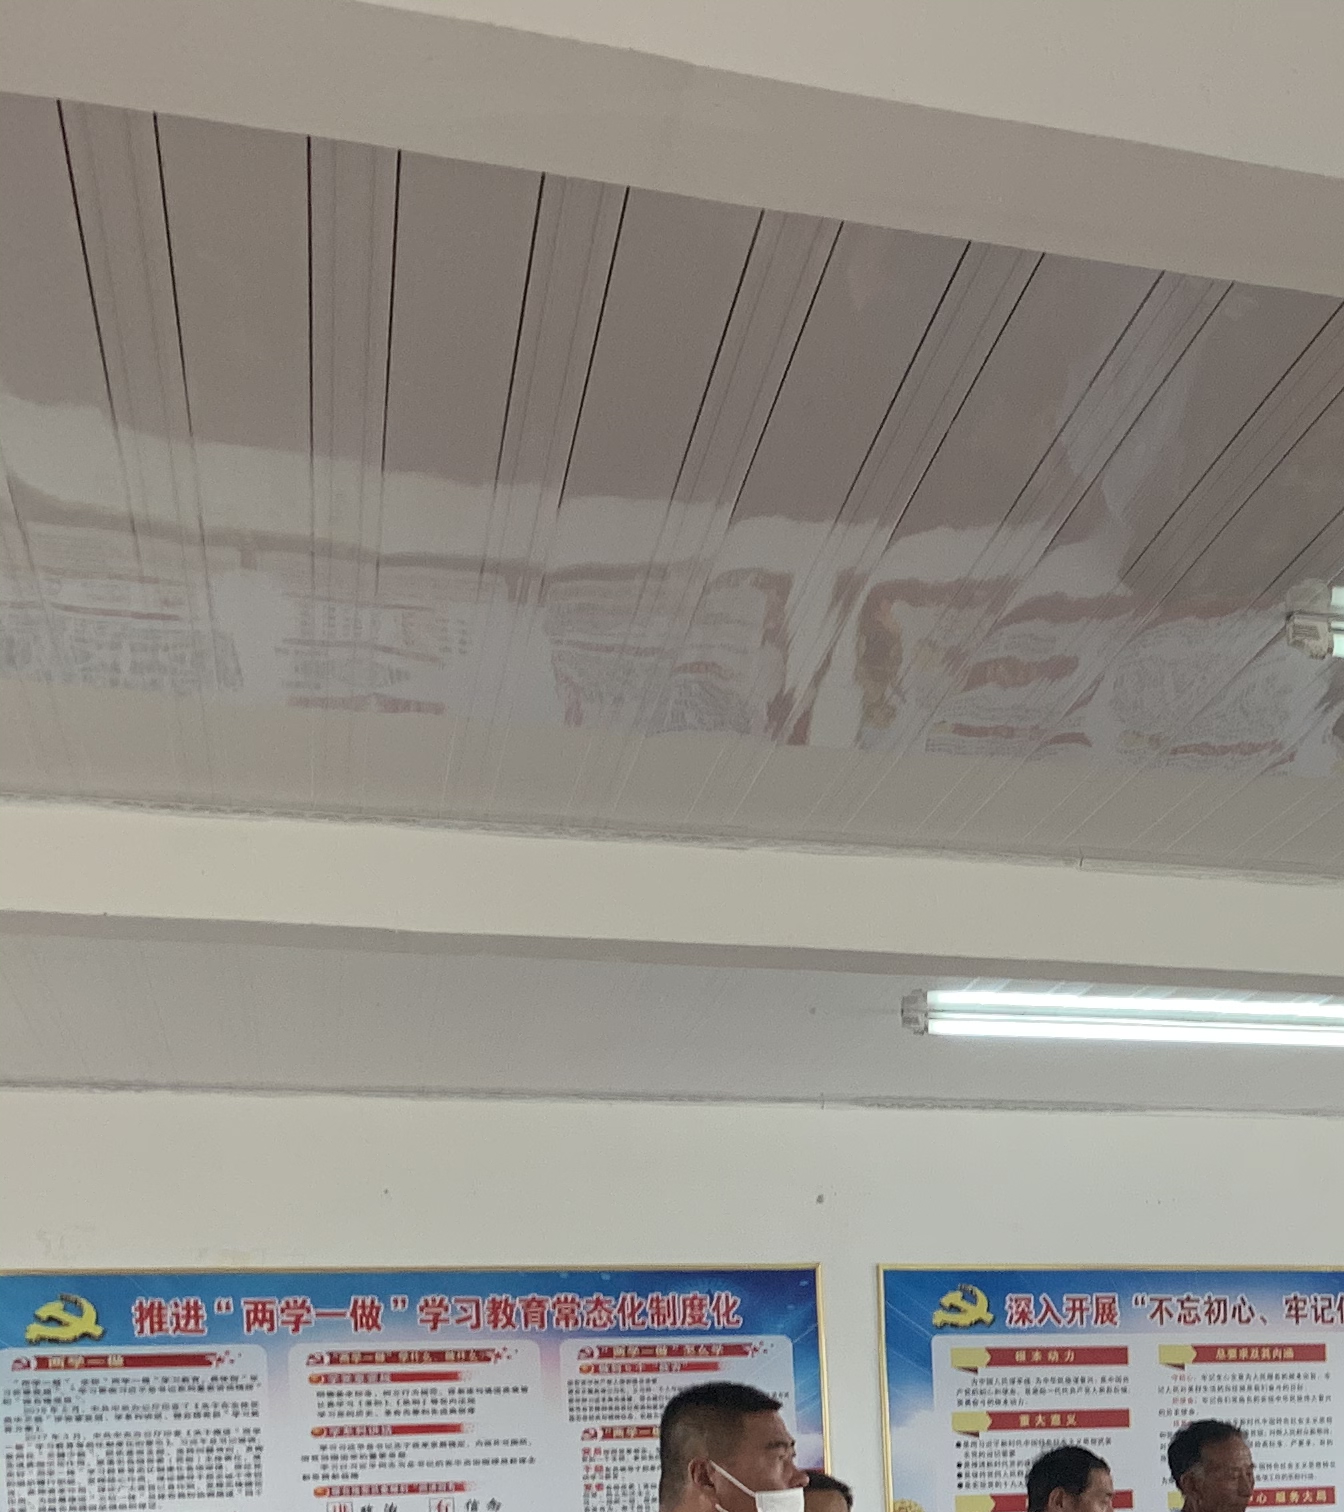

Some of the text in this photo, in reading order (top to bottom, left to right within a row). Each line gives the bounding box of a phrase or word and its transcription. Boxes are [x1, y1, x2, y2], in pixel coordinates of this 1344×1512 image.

[132, 1291, 742, 1336] 推进“两学一做”学习教育常态化制度化
[1015, 1349, 1075, 1363] 根本动力
[1019, 1414, 1077, 1427] 重大意义
[1275, 1491, 1326, 1503] 服务大局
